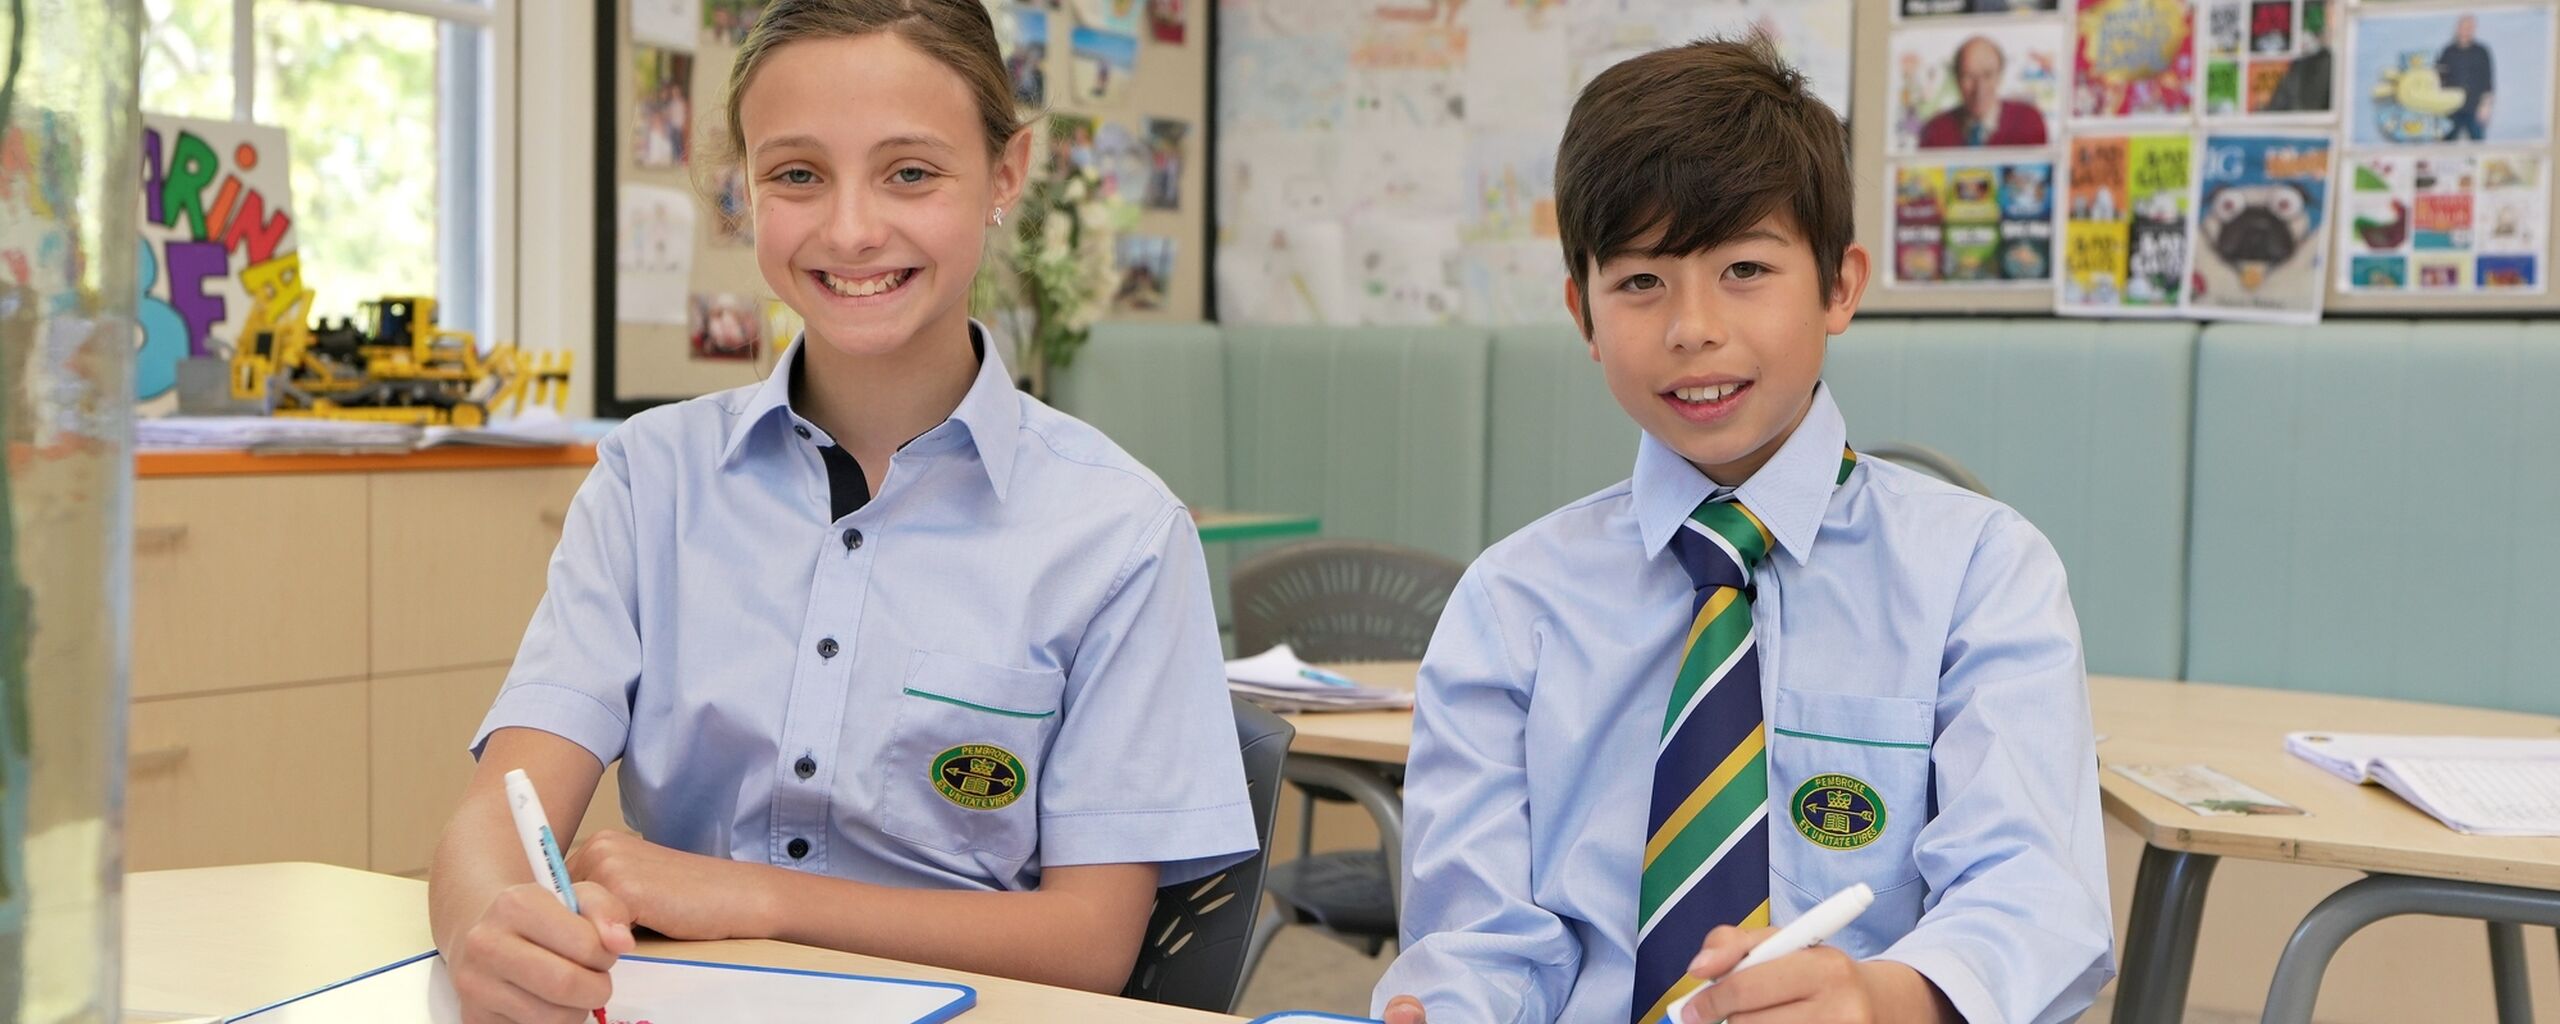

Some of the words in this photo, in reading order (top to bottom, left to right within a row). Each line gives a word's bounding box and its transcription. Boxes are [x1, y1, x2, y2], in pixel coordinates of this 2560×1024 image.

[961, 746, 1012, 764] PEMBROKE
[1815, 776, 1867, 795] PEMBROKE
[948, 789, 989, 808] UNITATE
[988, 791, 1015, 807] VIRES
[1799, 819, 1811, 834] EX
[1811, 827, 1852, 847] UNITATE
[1852, 828, 1878, 845] VIRES
